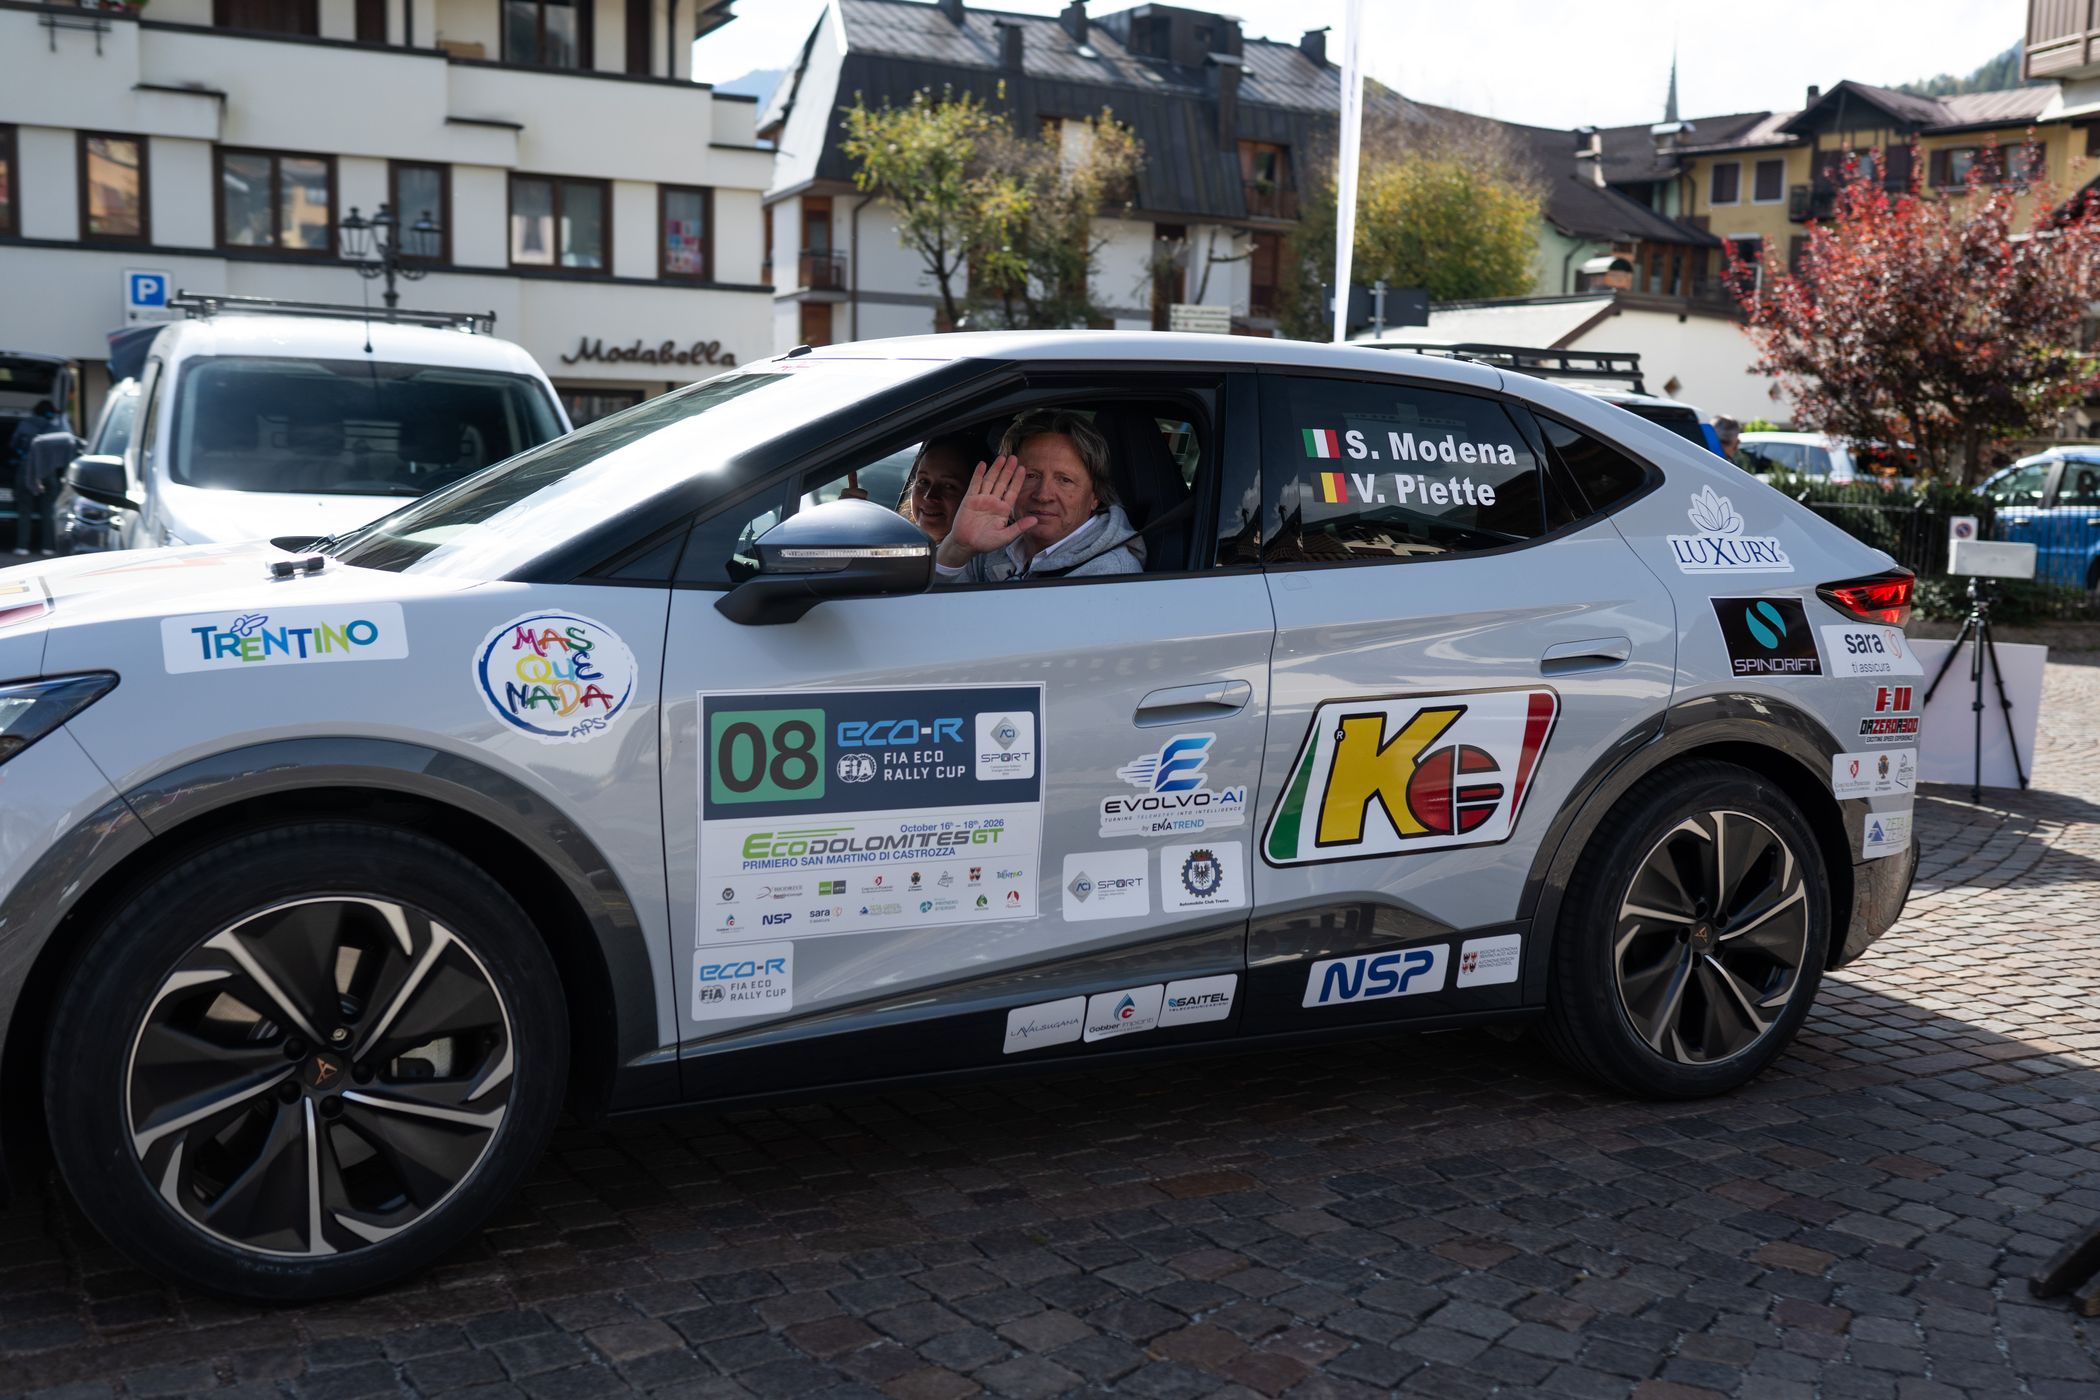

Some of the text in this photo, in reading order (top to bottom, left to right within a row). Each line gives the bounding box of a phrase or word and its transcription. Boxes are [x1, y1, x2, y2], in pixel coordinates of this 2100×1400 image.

[138, 279, 158, 301] P
[560, 336, 737, 366] Modabella
[1345, 430, 1517, 465] S. Modena
[1351, 473, 1496, 506] V. Piette
[1672, 538, 1780, 565] LUXURY
[191, 619, 378, 662] TRENTINO
[512, 626, 595, 657] MAS
[1844, 633, 1885, 654] sara
[1734, 658, 1816, 673] SPINDRIFT
[1851, 661, 1891, 673] ti assicura
[505, 680, 614, 718] NADA
[570, 717, 607, 738] APS
[718, 720, 818, 793] 08
[884, 750, 944, 764] FIA ECO
[981, 752, 1031, 763] SPORT
[884, 765, 966, 781] RALLY CUP
[1105, 790, 1243, 814] EVOLVO-AI
[1195, 806, 1241, 815] INTELLIGENCE
[900, 823, 937, 833] October
[983, 818, 1004, 828] 2026
[743, 847, 956, 870] PRIMIERO SAN MARTINO DI CASTROZZA
[1098, 878, 1143, 889] SPORT
[762, 913, 792, 925] NSP
[809, 908, 830, 917] sara
[731, 979, 771, 990] FIA ECO
[1318, 950, 1434, 1003] NSP
[730, 988, 786, 1000] RALLY CUP
[1177, 992, 1229, 1007] SAITEL
[1089, 1023, 1120, 1033] Gobber
